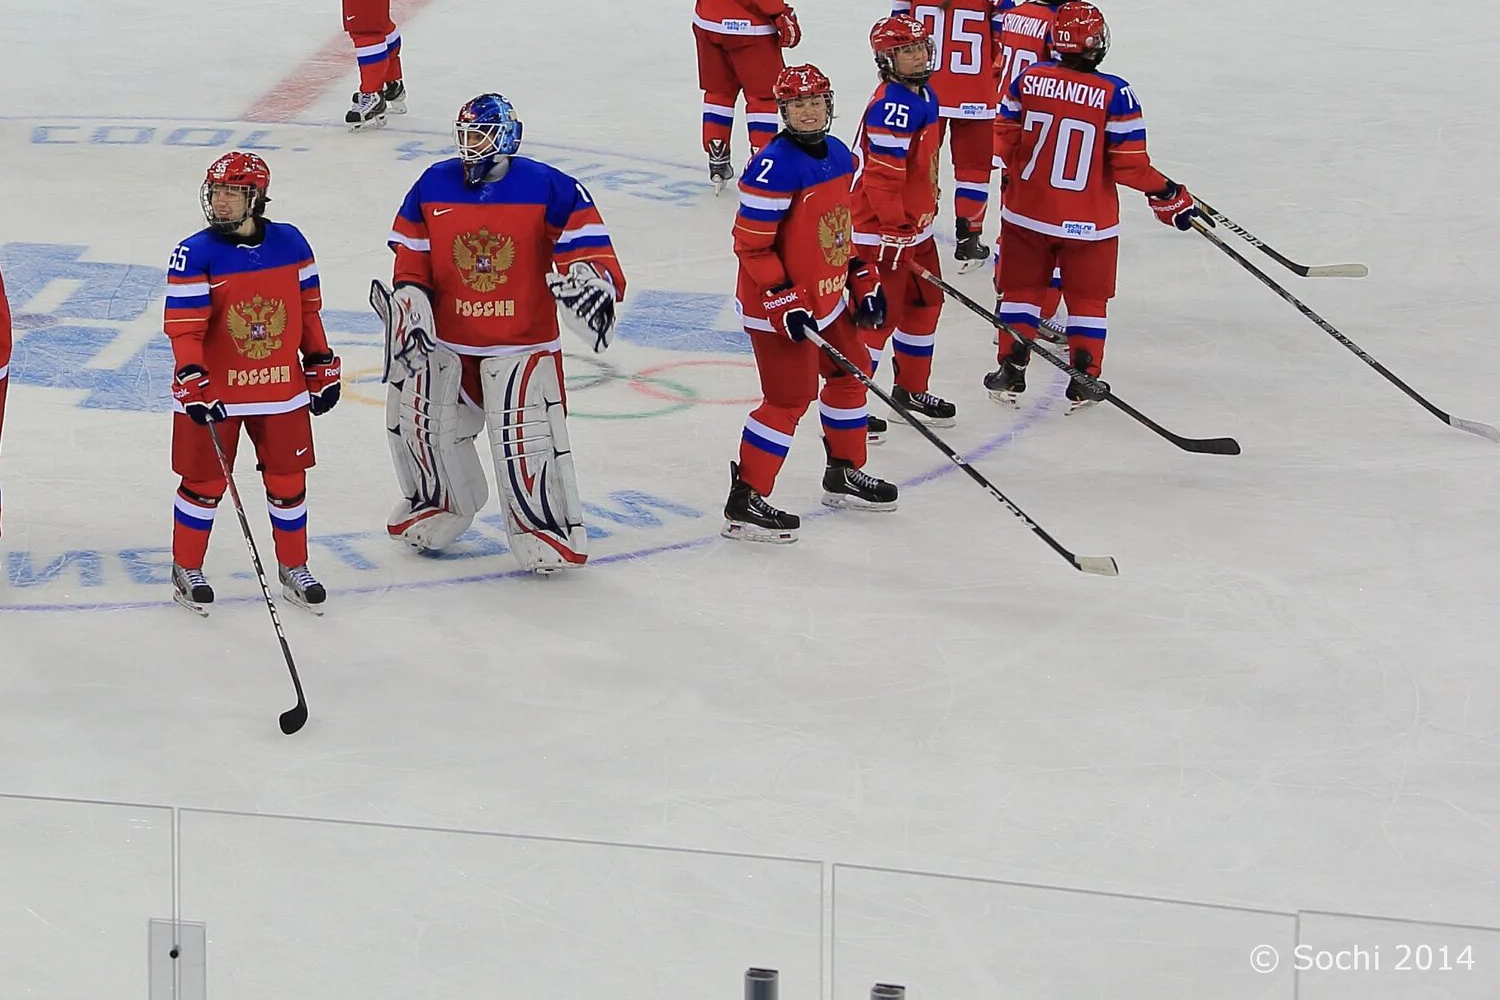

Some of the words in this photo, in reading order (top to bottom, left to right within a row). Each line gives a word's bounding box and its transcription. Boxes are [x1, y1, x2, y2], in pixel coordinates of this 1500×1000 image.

[1002, 14, 1048, 40] SHOKHINA
[1058, 31, 1071, 41] 70
[1023, 75, 1106, 110] SHIBANOVA
[884, 102, 910, 128] 25
[1021, 110, 1096, 192] 70
[756, 159, 773, 183] 2
[455, 299, 515, 318] РОССИЯ
[763, 292, 799, 311] Reebok
[228, 365, 290, 387] РОССИЯ
